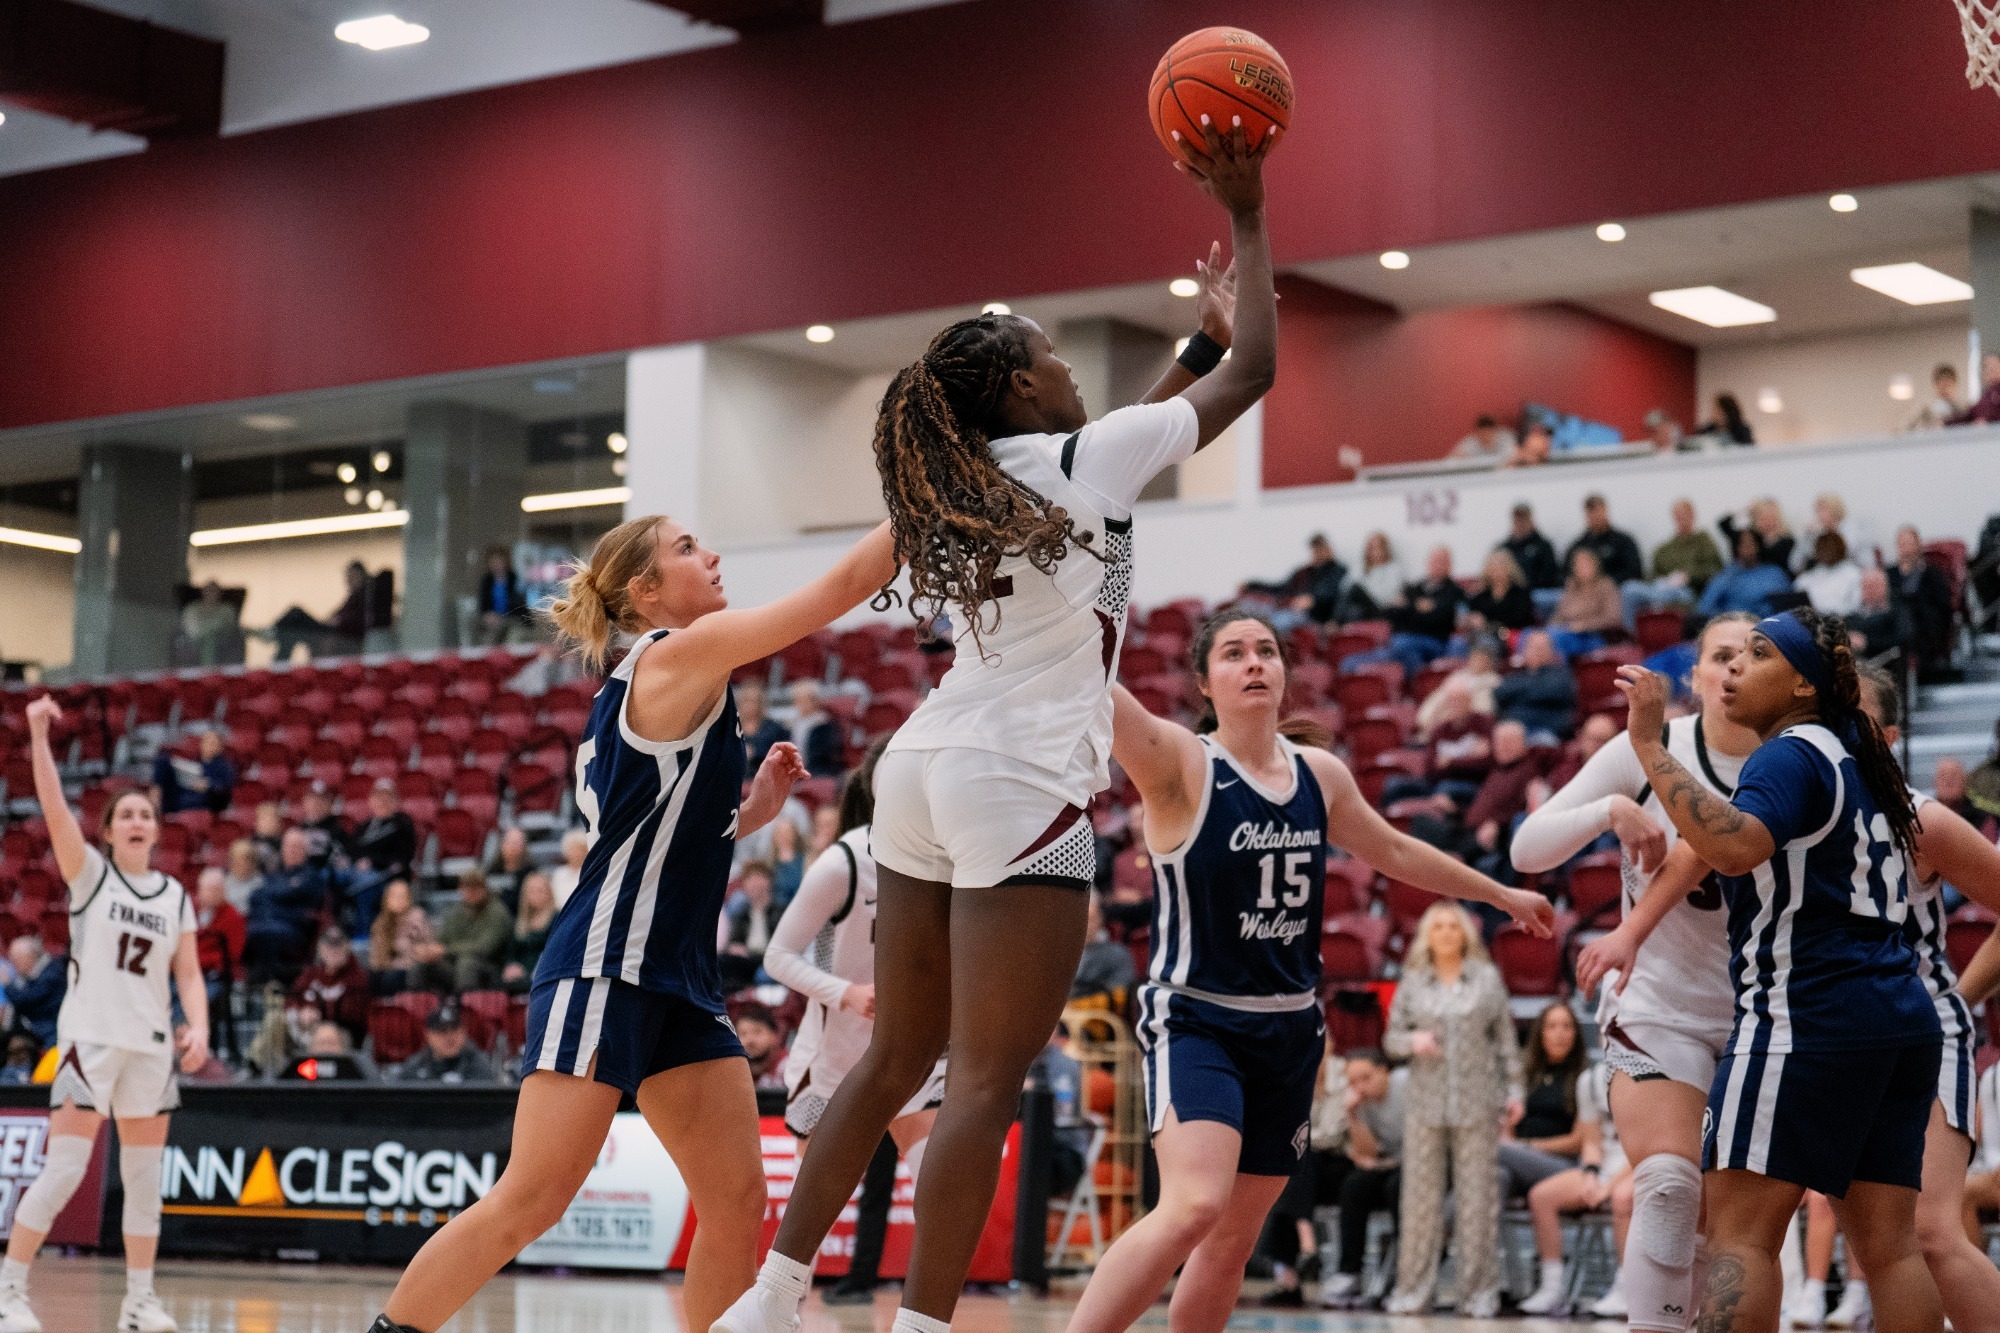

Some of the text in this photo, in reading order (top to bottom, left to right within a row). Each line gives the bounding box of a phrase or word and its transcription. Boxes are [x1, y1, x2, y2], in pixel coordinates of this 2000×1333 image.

[1405, 489, 1458, 526] 102
[1228, 820, 1321, 852] Oklahoma
[1256, 851, 1312, 909] 15
[108, 901, 168, 937] EVANGEL
[1238, 909, 1308, 946] Wesleya
[115, 931, 153, 977] 12
